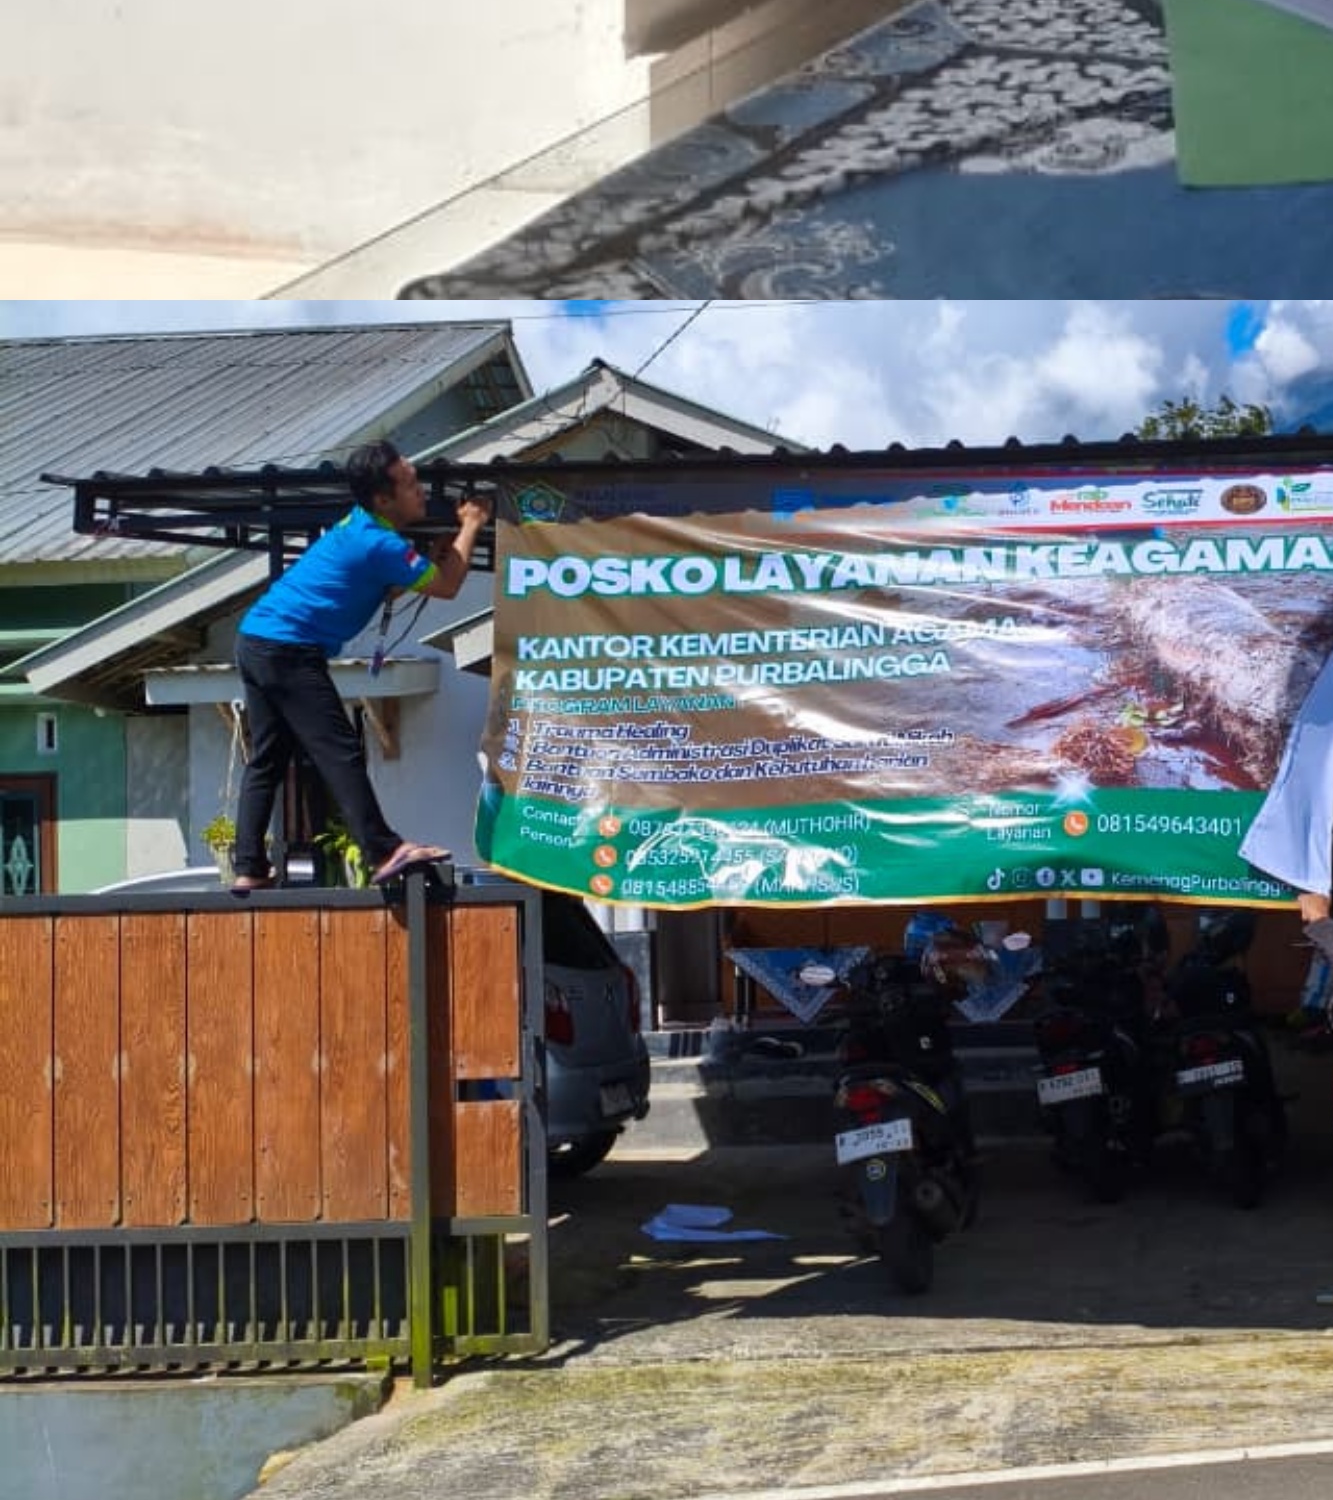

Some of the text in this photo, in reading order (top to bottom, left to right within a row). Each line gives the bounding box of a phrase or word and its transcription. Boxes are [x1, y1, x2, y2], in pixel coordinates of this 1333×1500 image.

[508, 556, 717, 596] POSKO
[723, 547, 1005, 592] LAYANAN
[518, 634, 654, 660] KANTOR
[659, 624, 884, 658] KEMENTERIAN
[515, 650, 951, 691] KABUPATEN PURBALINGGA
[616, 720, 691, 741] Healing
[522, 805, 581, 827] Contac
[1097, 813, 1242, 836] 081549643401
